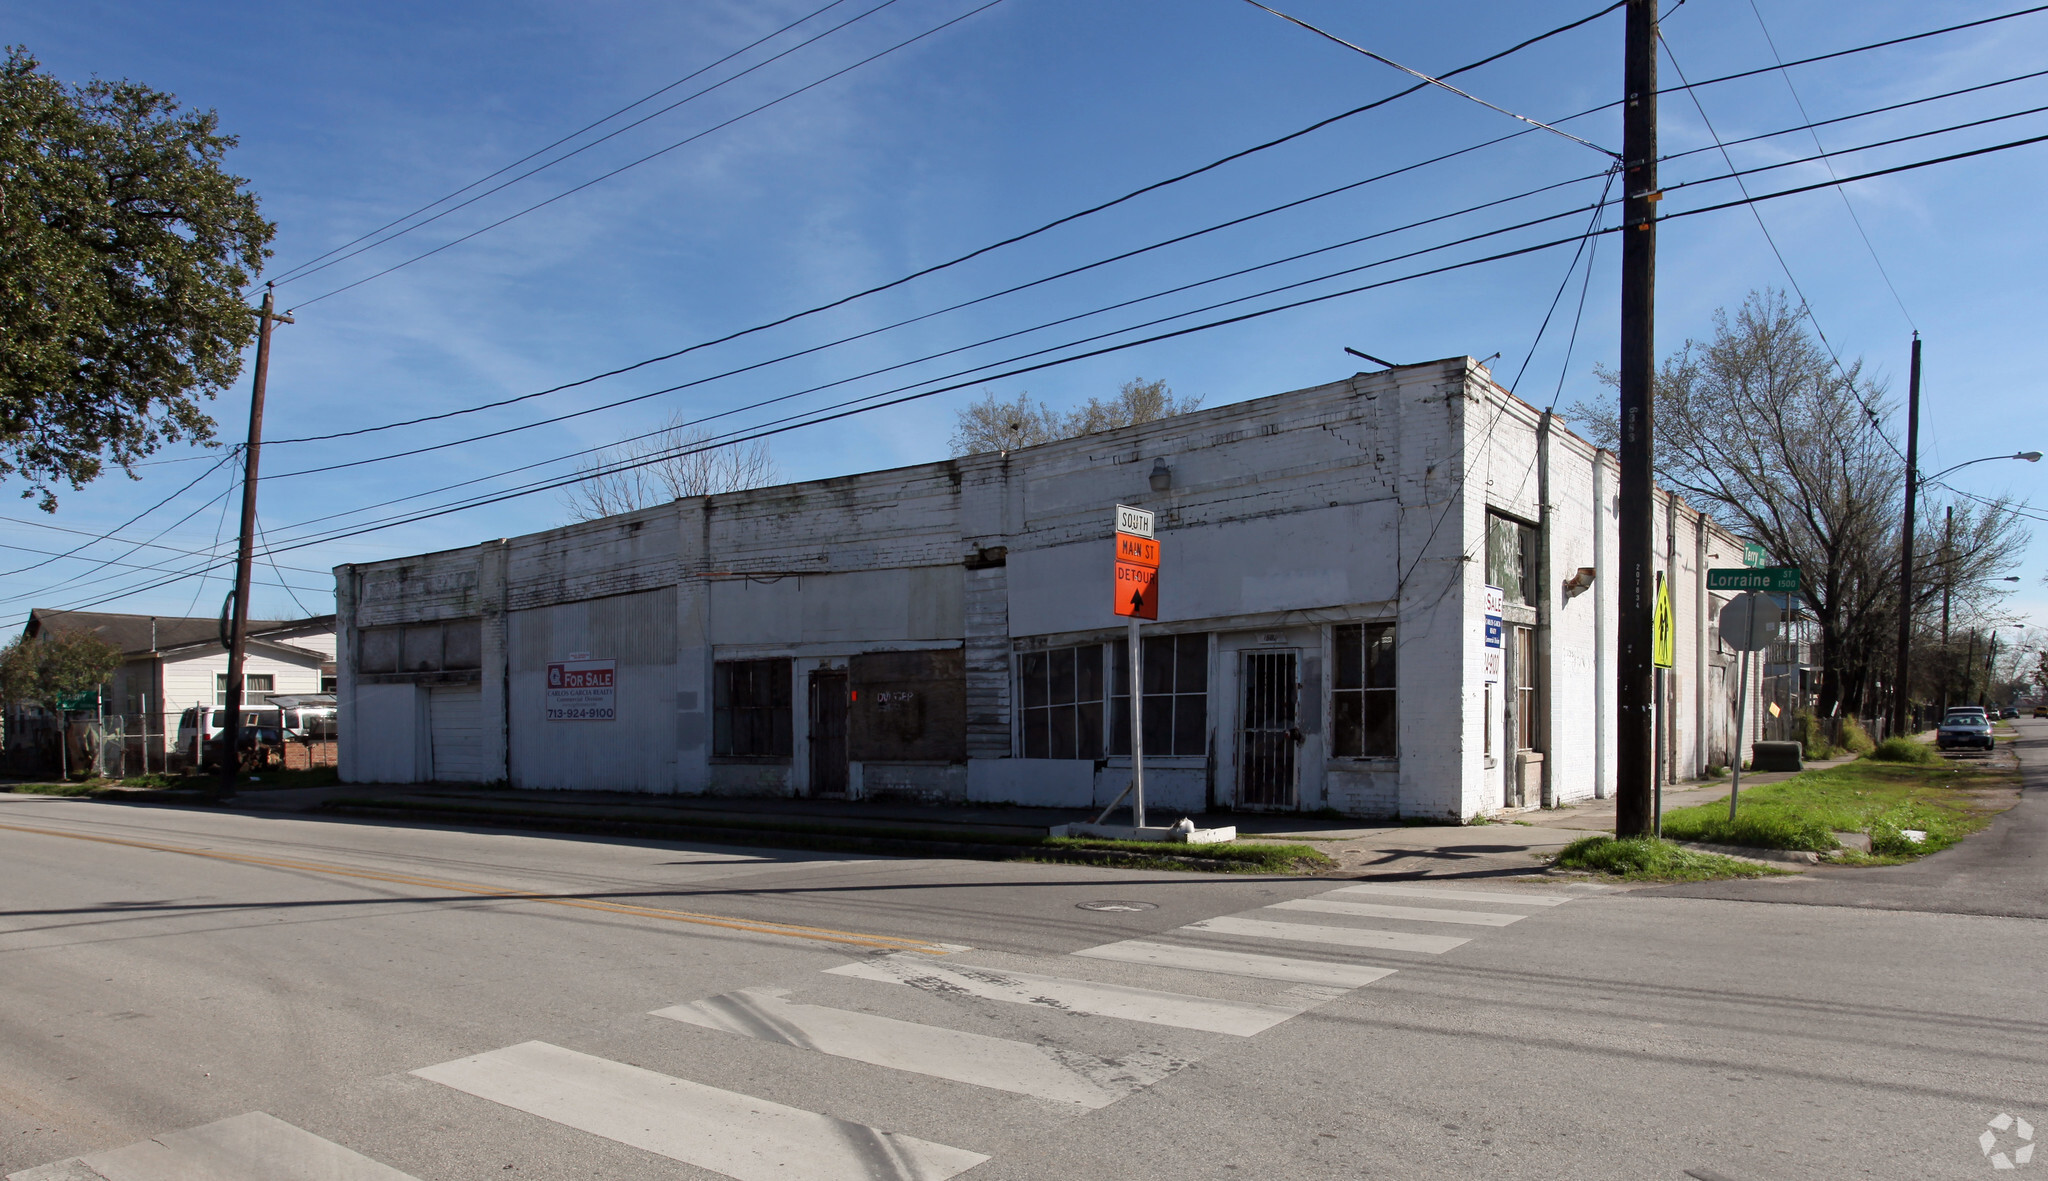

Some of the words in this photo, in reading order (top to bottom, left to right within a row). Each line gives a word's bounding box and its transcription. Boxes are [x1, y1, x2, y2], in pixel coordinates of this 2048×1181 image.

[1122, 512, 1149, 531] SOUTH
[1122, 539, 1142, 557] MAIN
[1145, 545, 1154, 560] ST
[1744, 547, 1759, 568] Terry
[1118, 567, 1155, 584] DETOUR
[1710, 573, 1771, 587] Lorraine
[1778, 580, 1796, 588] 1500
[564, 673, 584, 687] FOR
[586, 672, 612, 687] SALE
[547, 708, 614, 718] 713-924-9100
